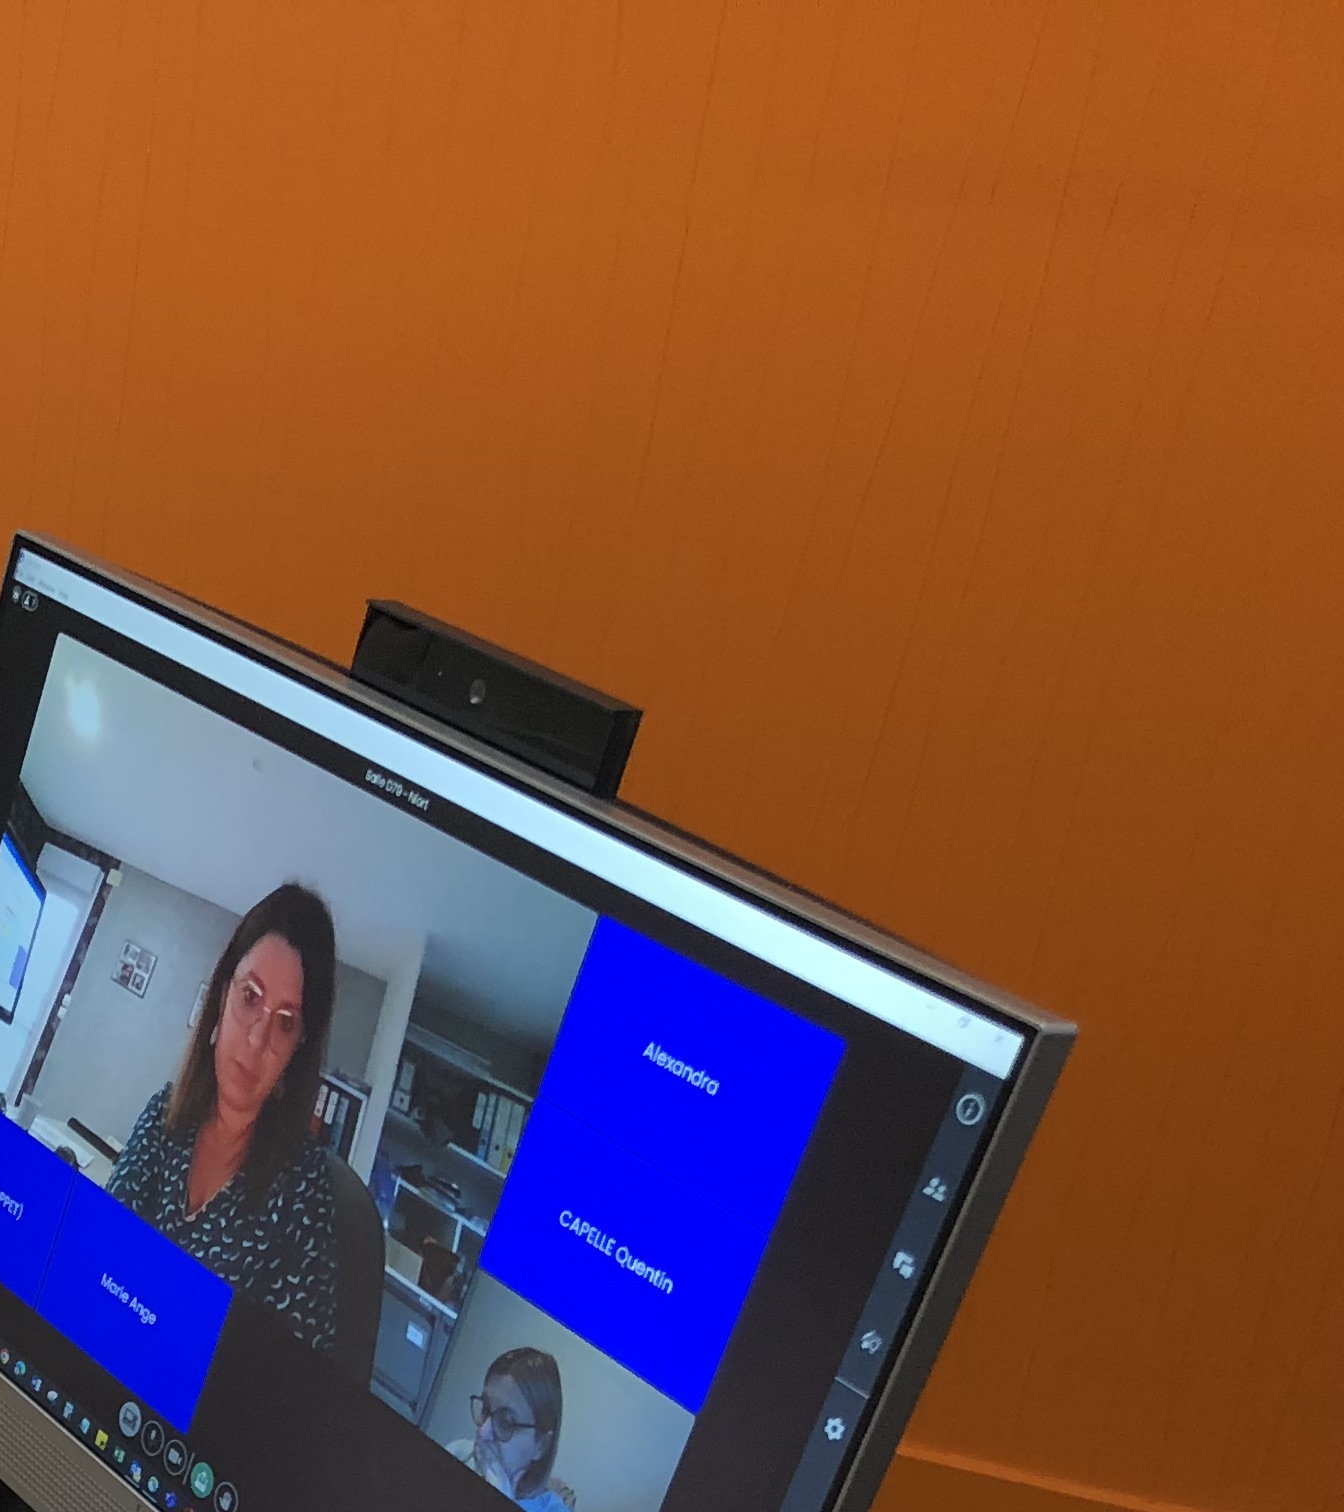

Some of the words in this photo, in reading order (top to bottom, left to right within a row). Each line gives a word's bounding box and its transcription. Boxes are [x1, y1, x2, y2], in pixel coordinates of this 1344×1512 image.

[642, 1041, 720, 1096] Alexandra
[559, 1210, 616, 1257] CAPELLE
[615, 1246, 674, 1295] Quentin
[100, 1272, 130, 1305] Marie
[128, 1294, 158, 1325] Ange
